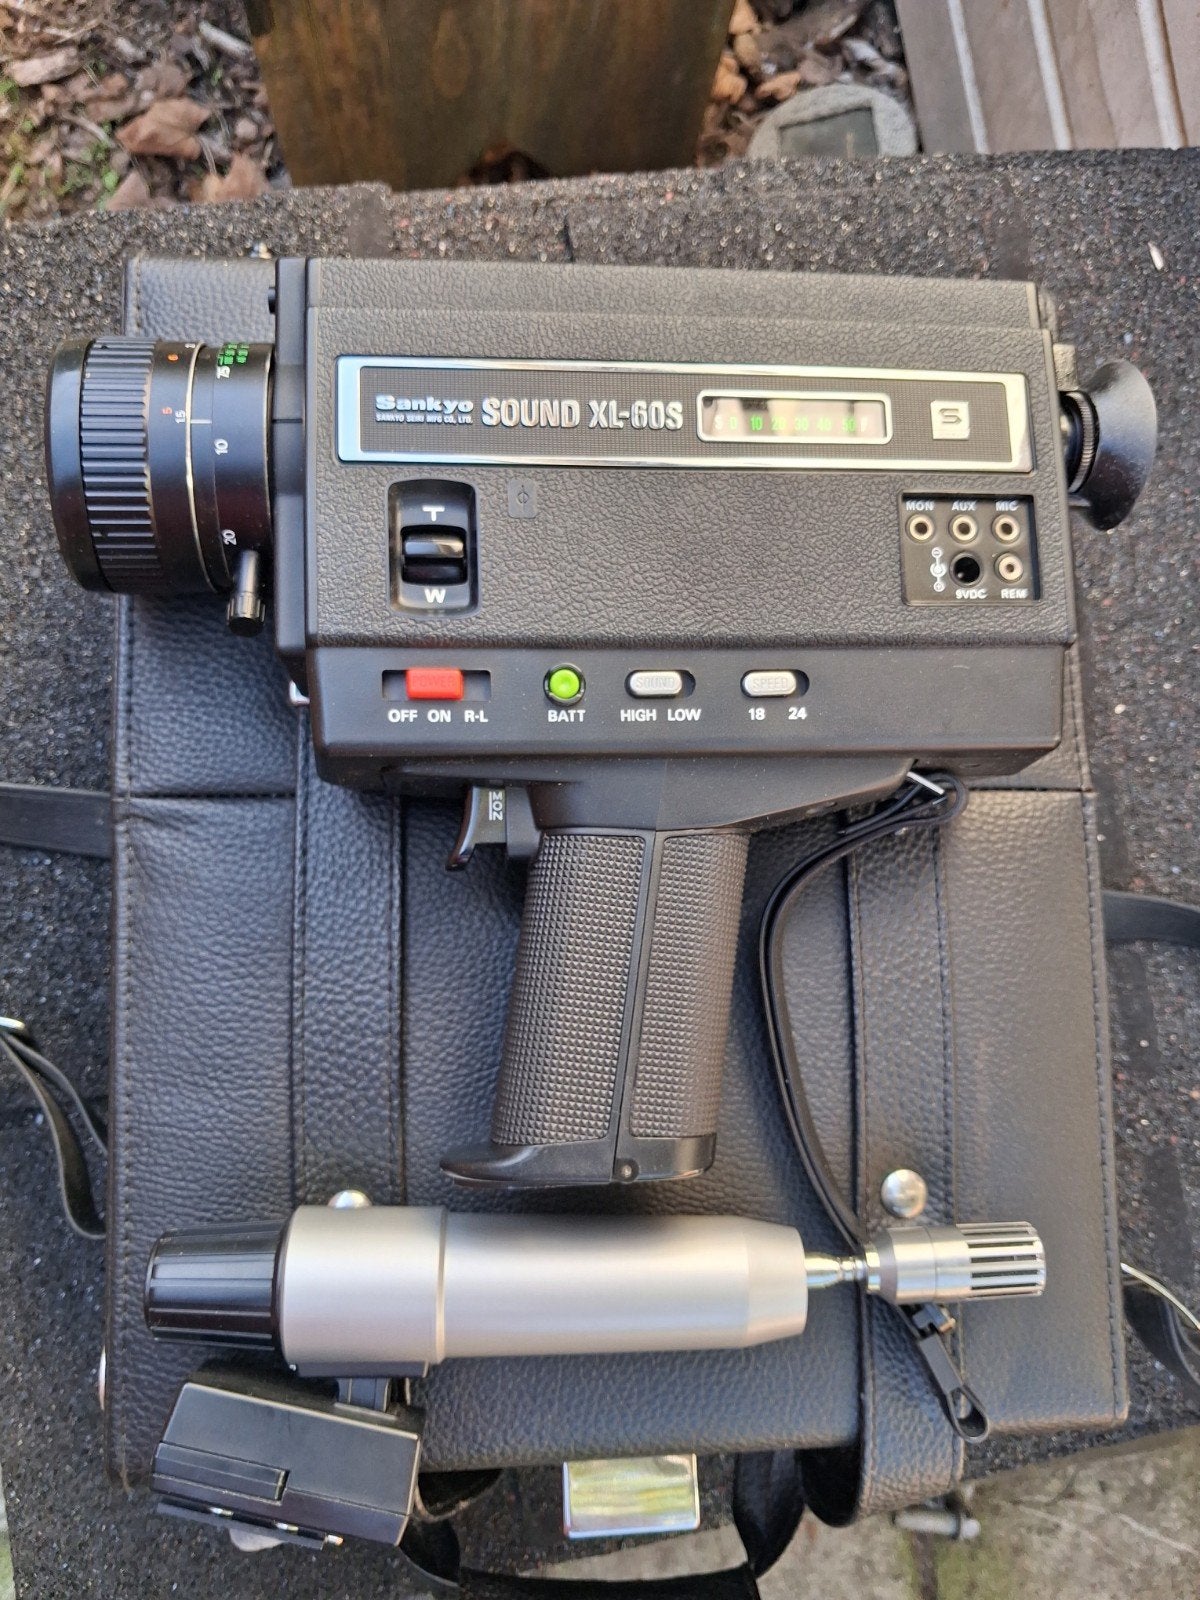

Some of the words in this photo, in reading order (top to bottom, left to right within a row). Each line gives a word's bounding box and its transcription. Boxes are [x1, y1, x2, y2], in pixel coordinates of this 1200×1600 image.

[375, 394, 474, 415] Sankyo
[481, 396, 581, 428] SOUND
[587, 398, 684, 431] XL-60S
[750, 415, 764, 431] 10
[771, 415, 787, 431] 20
[794, 415, 810, 431] 30
[213, 438, 229, 455] 10
[422, 505, 446, 522] T
[905, 500, 935, 512] MON
[951, 500, 978, 512] AUX
[995, 501, 1020, 512] MIC
[221, 528, 238, 546] 20
[424, 589, 447, 604] W
[1001, 588, 1029, 600] REM
[635, 675, 676, 689] SOUND
[752, 676, 789, 690] SPEED
[387, 708, 418, 723] OFF
[426, 708, 452, 723] ON
[463, 708, 489, 723] R-L
[547, 708, 586, 723] BATT
[619, 708, 658, 722] HIGH
[666, 708, 702, 722] LOW
[748, 707, 766, 721] 18
[787, 706, 808, 721] 24
